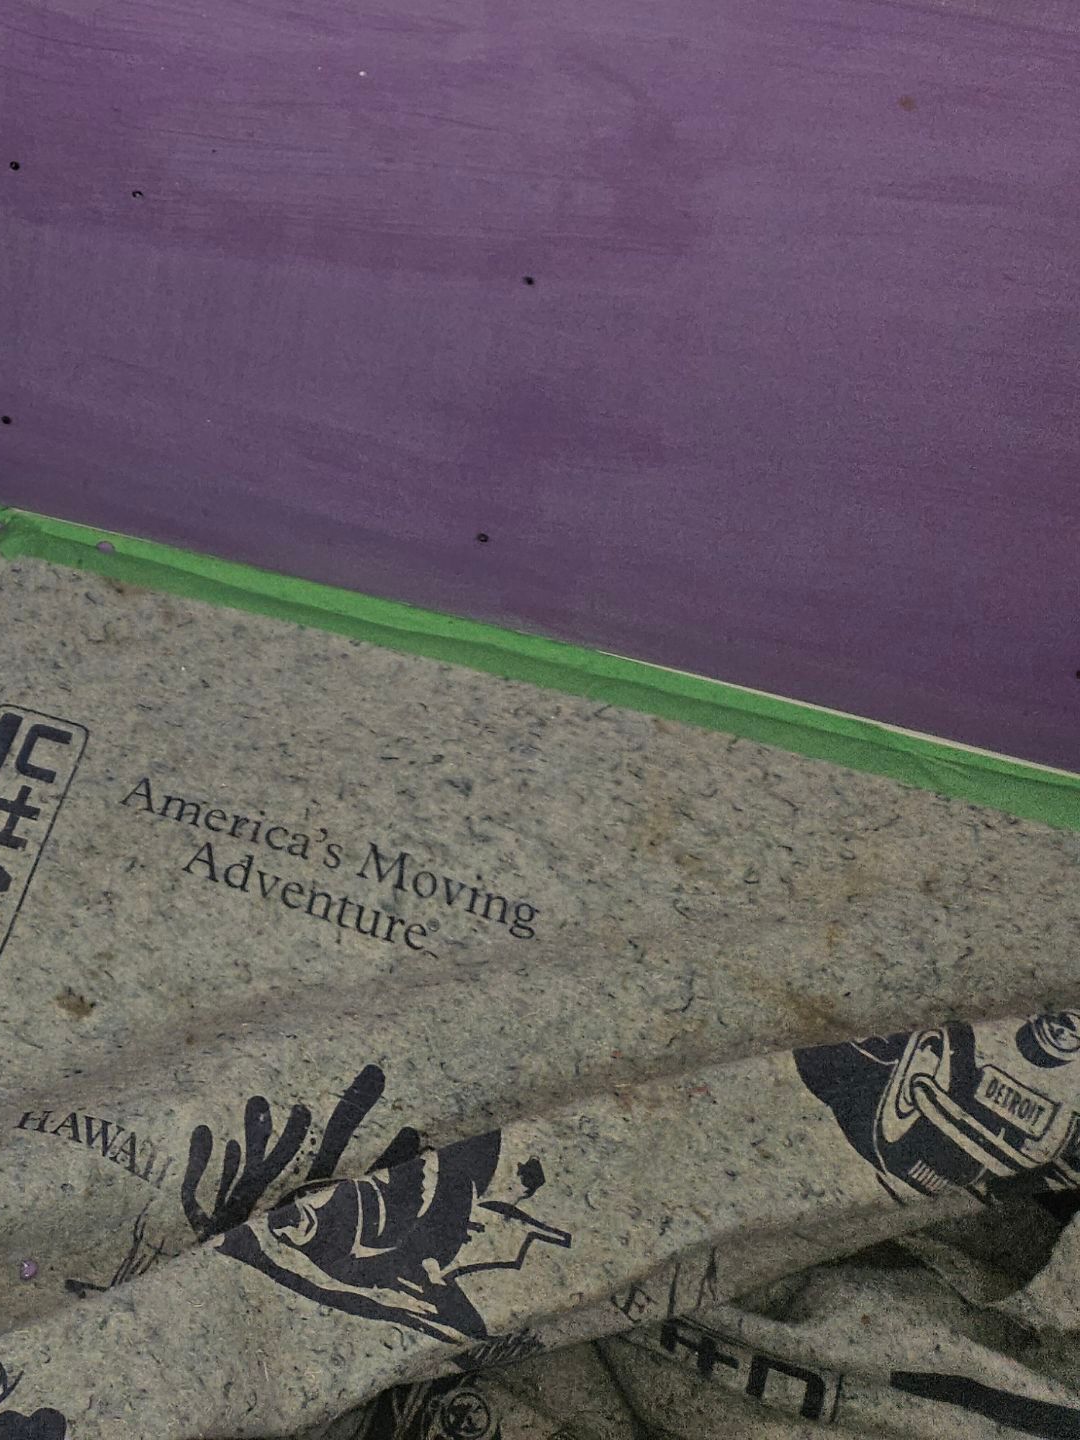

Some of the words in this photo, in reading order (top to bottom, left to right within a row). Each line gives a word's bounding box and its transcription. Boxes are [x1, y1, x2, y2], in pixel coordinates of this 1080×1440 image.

[121, 777, 343, 869] America's
[356, 842, 540, 940] Moving
[182, 841, 428, 951] Adventure
[984, 1076, 1046, 1127] DETROIT
